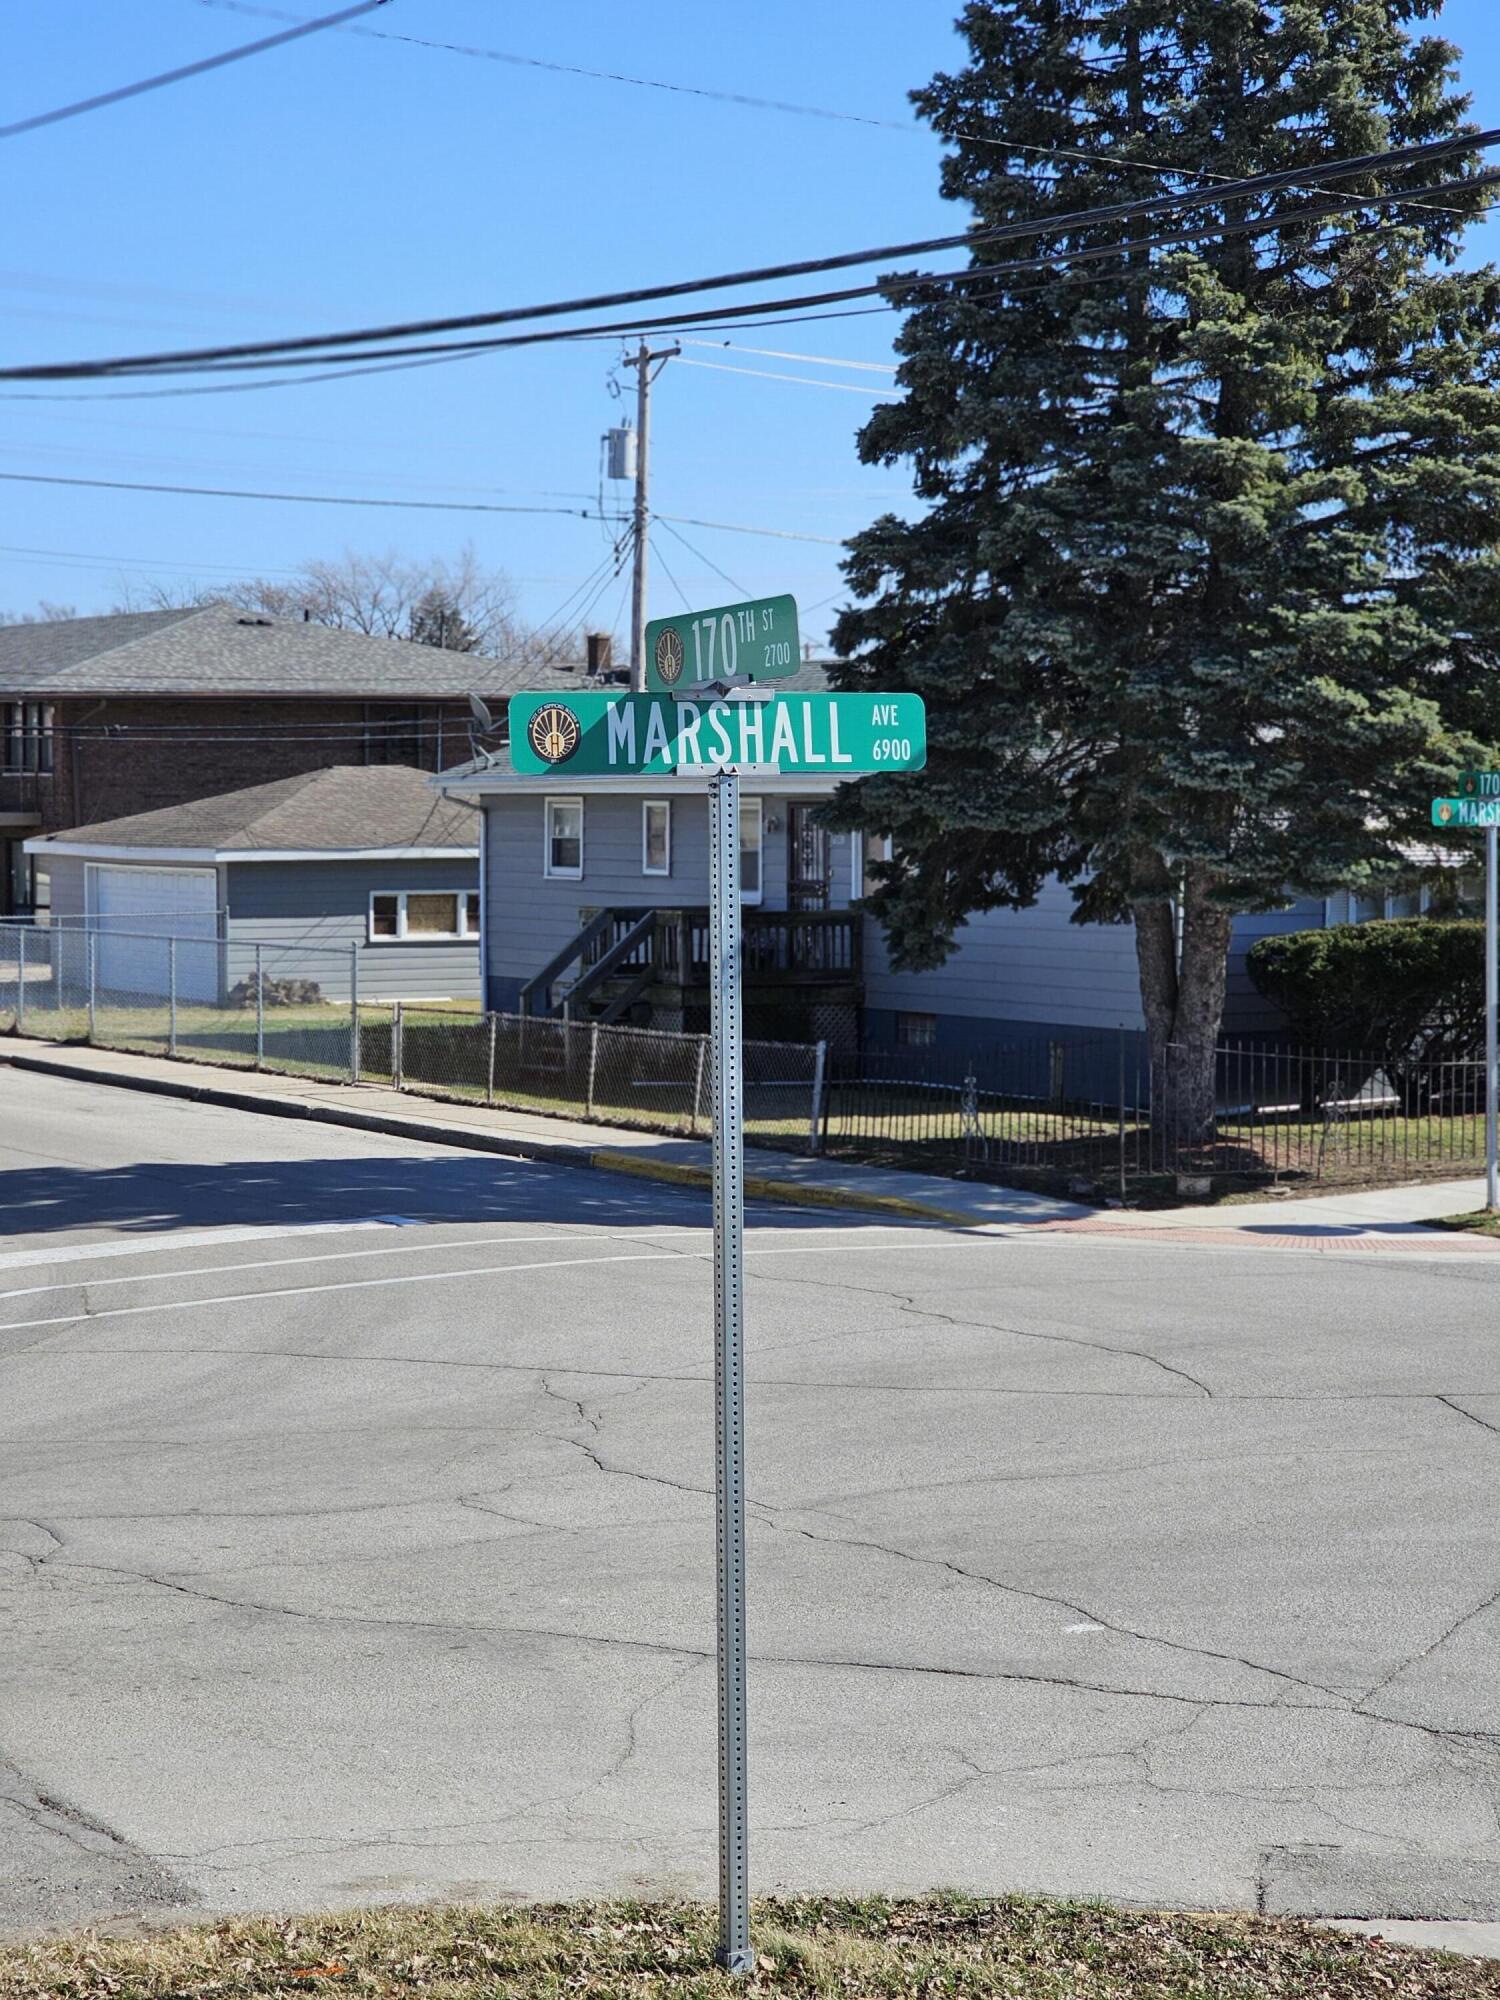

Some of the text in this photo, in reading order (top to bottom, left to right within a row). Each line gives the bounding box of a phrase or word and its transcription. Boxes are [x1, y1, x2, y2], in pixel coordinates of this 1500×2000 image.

[762, 608, 773, 631] ST
[764, 642, 791, 667] 2700
[606, 701, 899, 764] MARSHALL AVE
[873, 739, 911, 761] 6900
